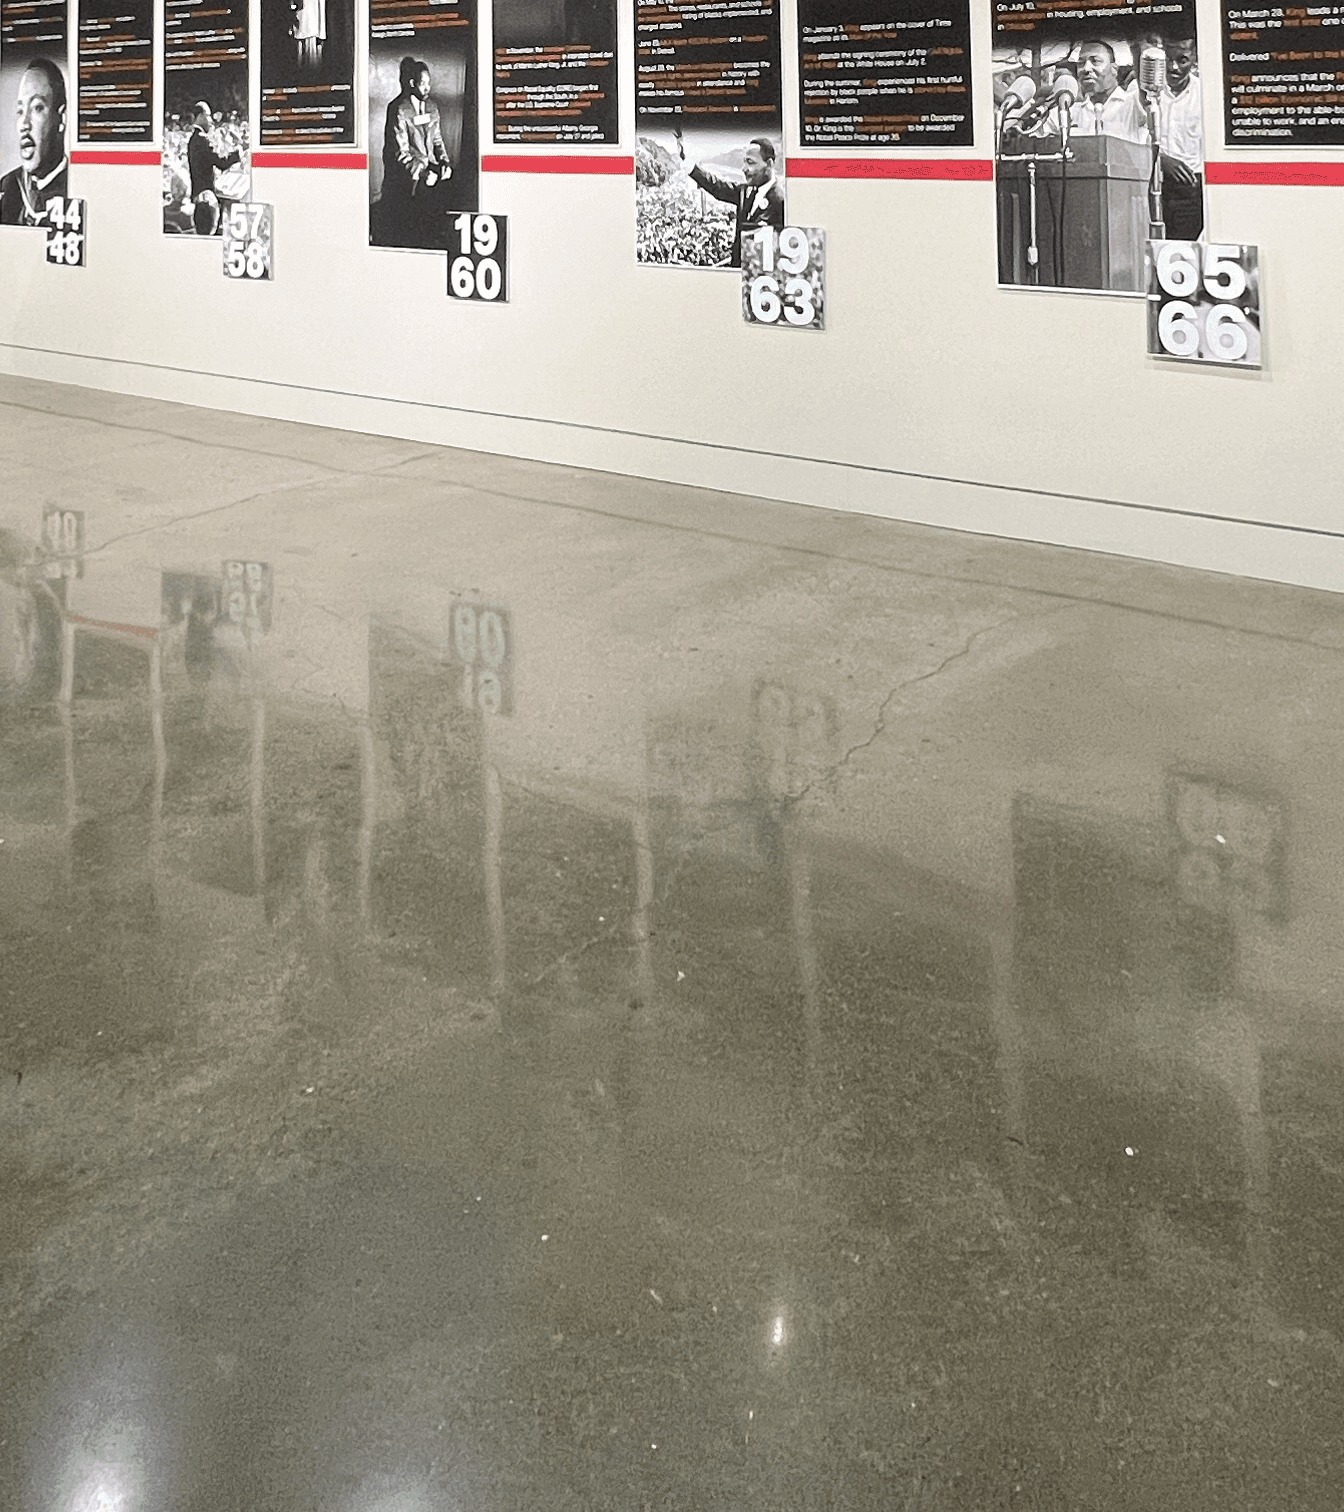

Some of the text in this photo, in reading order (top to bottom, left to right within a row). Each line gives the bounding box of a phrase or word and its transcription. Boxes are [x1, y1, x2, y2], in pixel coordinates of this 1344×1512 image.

[46, 196, 81, 231] 44
[230, 203, 264, 239] 57
[454, 213, 498, 256] 19
[46, 231, 81, 265] 48
[228, 241, 265, 278] 58
[754, 226, 809, 274] 19
[450, 256, 501, 300] 60
[1156, 244, 1249, 300] 65
[751, 276, 815, 325] 63
[1157, 300, 1248, 361] 66
